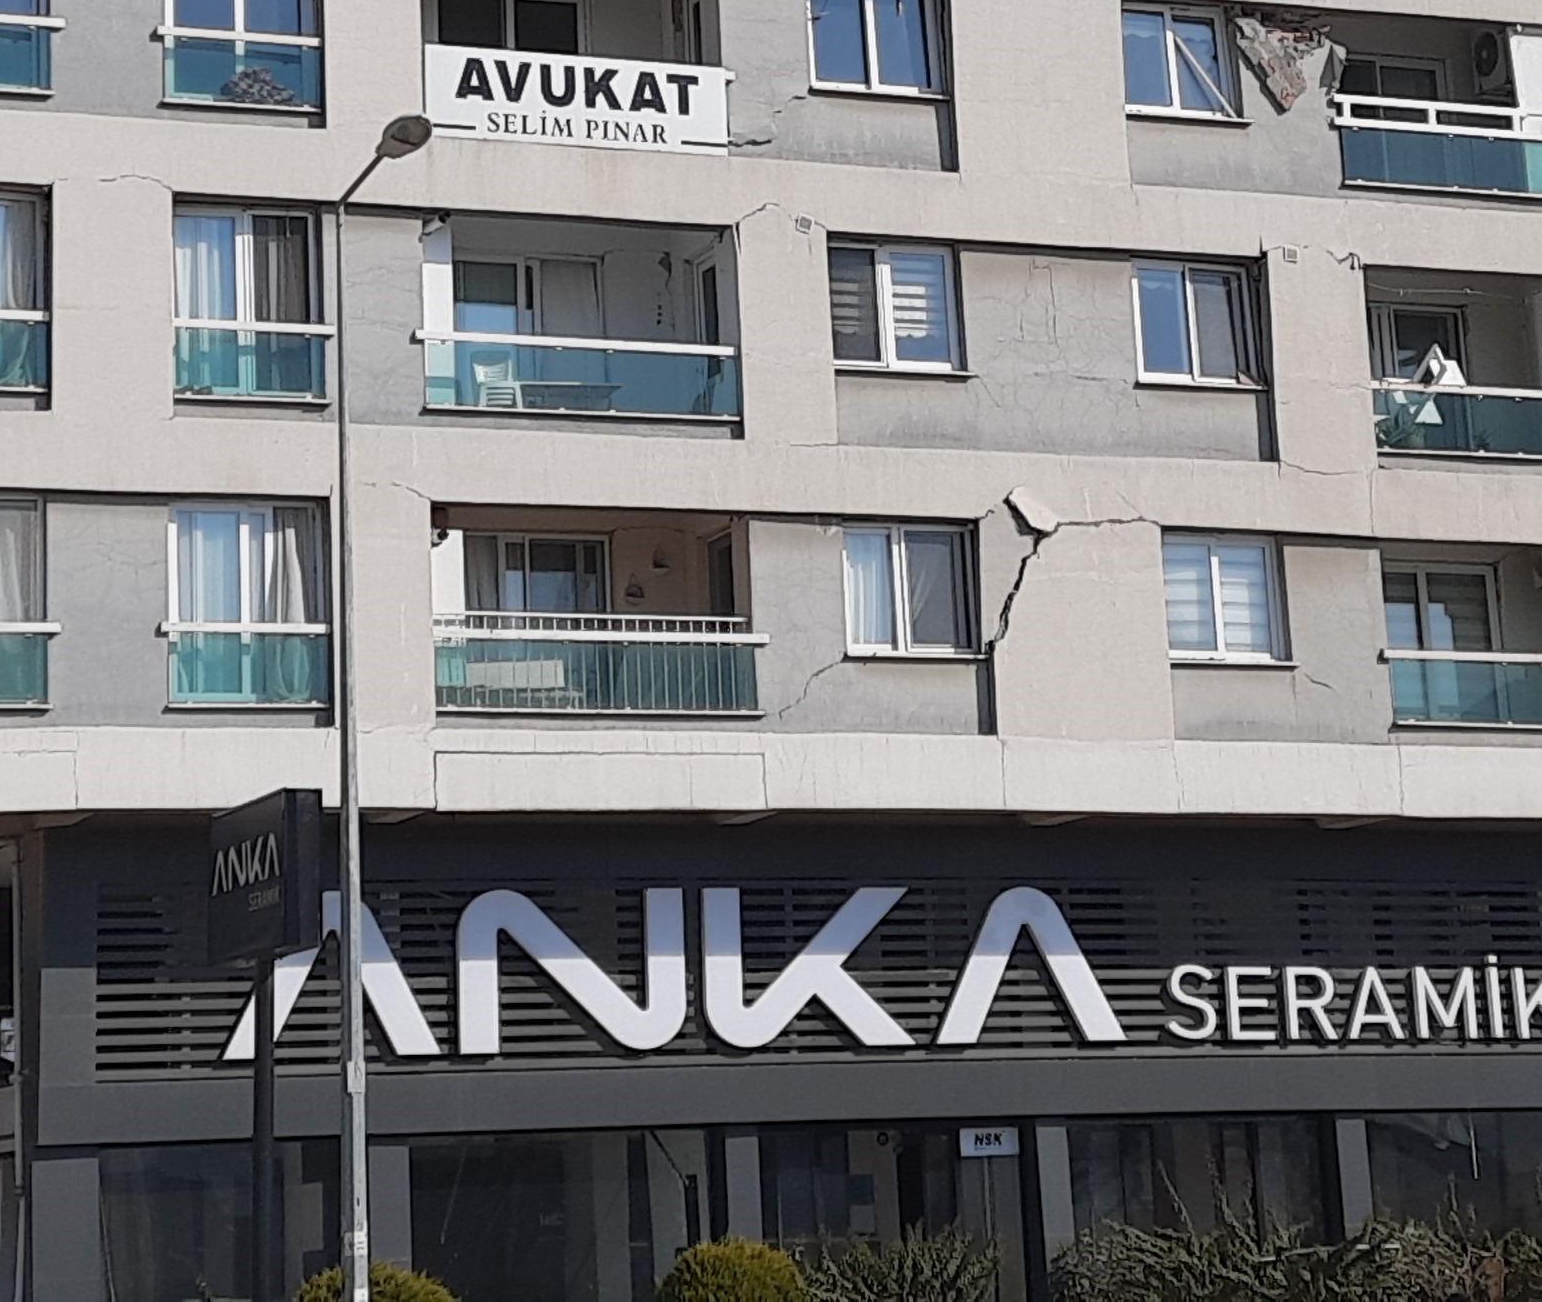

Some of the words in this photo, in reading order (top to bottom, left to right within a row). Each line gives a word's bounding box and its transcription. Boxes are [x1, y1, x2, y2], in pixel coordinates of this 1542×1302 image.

[455, 57, 699, 116] AVUKAT
[487, 110, 574, 138] SELİM
[585, 119, 669, 144] PINAR
[211, 831, 280, 897] ANKA
[221, 885, 1127, 1061] ANKA
